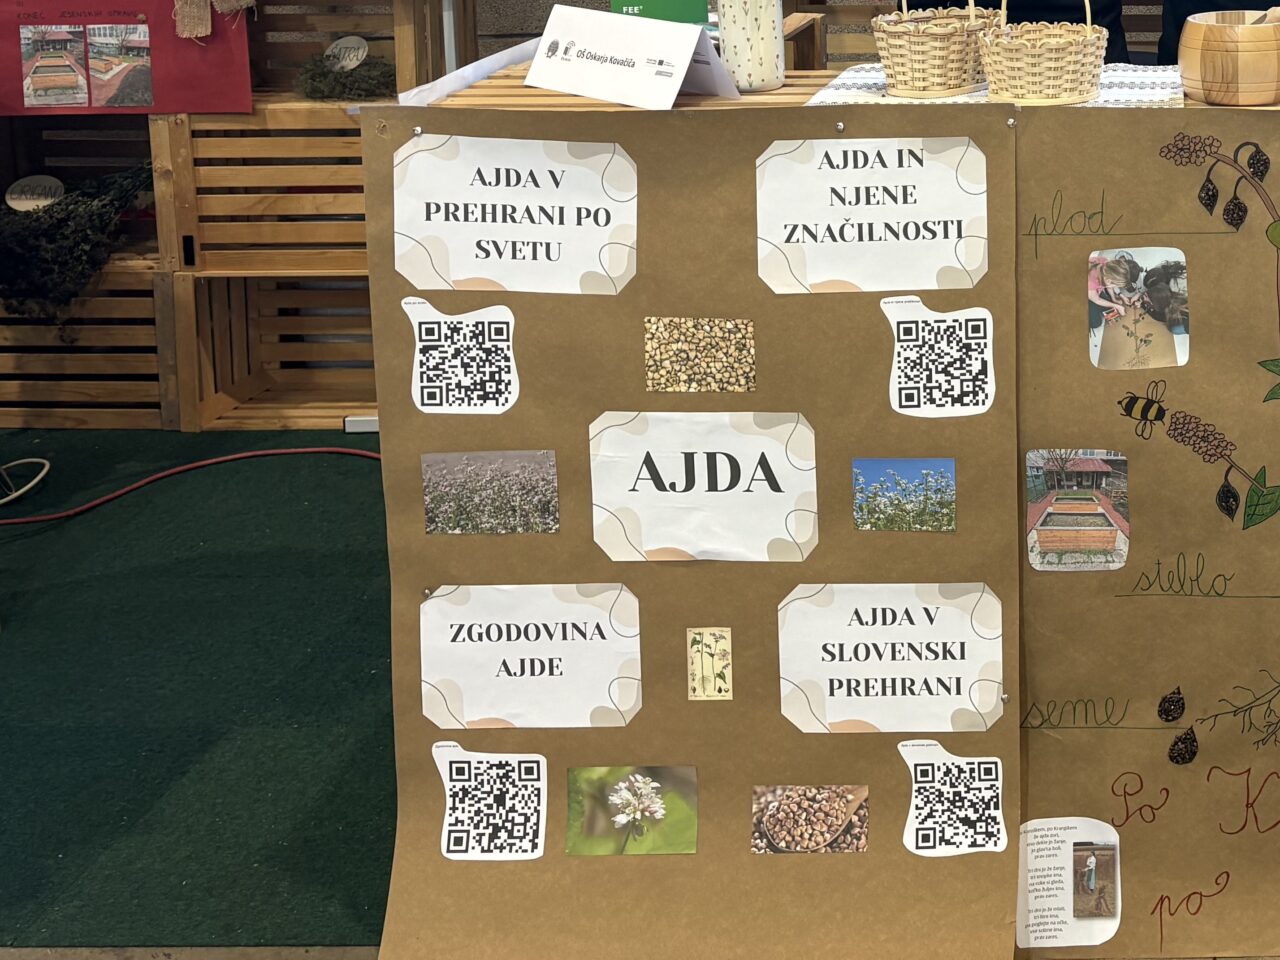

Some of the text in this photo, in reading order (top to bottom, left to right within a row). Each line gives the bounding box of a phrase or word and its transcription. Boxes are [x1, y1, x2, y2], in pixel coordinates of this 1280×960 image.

[623, 6, 640, 14] FEE
[817, 148, 924, 170] AJDA IN
[469, 167, 566, 190] AJDA V
[829, 185, 918, 207] NJENE
[424, 201, 612, 228] PREHRANI PO
[1027, 189, 1123, 260] plod
[784, 218, 963, 244] ZNAČILNOSTI
[474, 239, 563, 262] SVETU
[627, 450, 786, 495] AJDA
[1131, 552, 1235, 597] steblo
[847, 606, 941, 627] AJDA V
[449, 622, 608, 643] ZGODOVINA
[821, 641, 967, 663] SLOVENSKI
[495, 657, 563, 678] AJDE
[828, 676, 963, 697] PREHRANI
[1020, 693, 1130, 729] seme
[1110, 771, 1170, 829] Po
[1150, 871, 1231, 954] po
